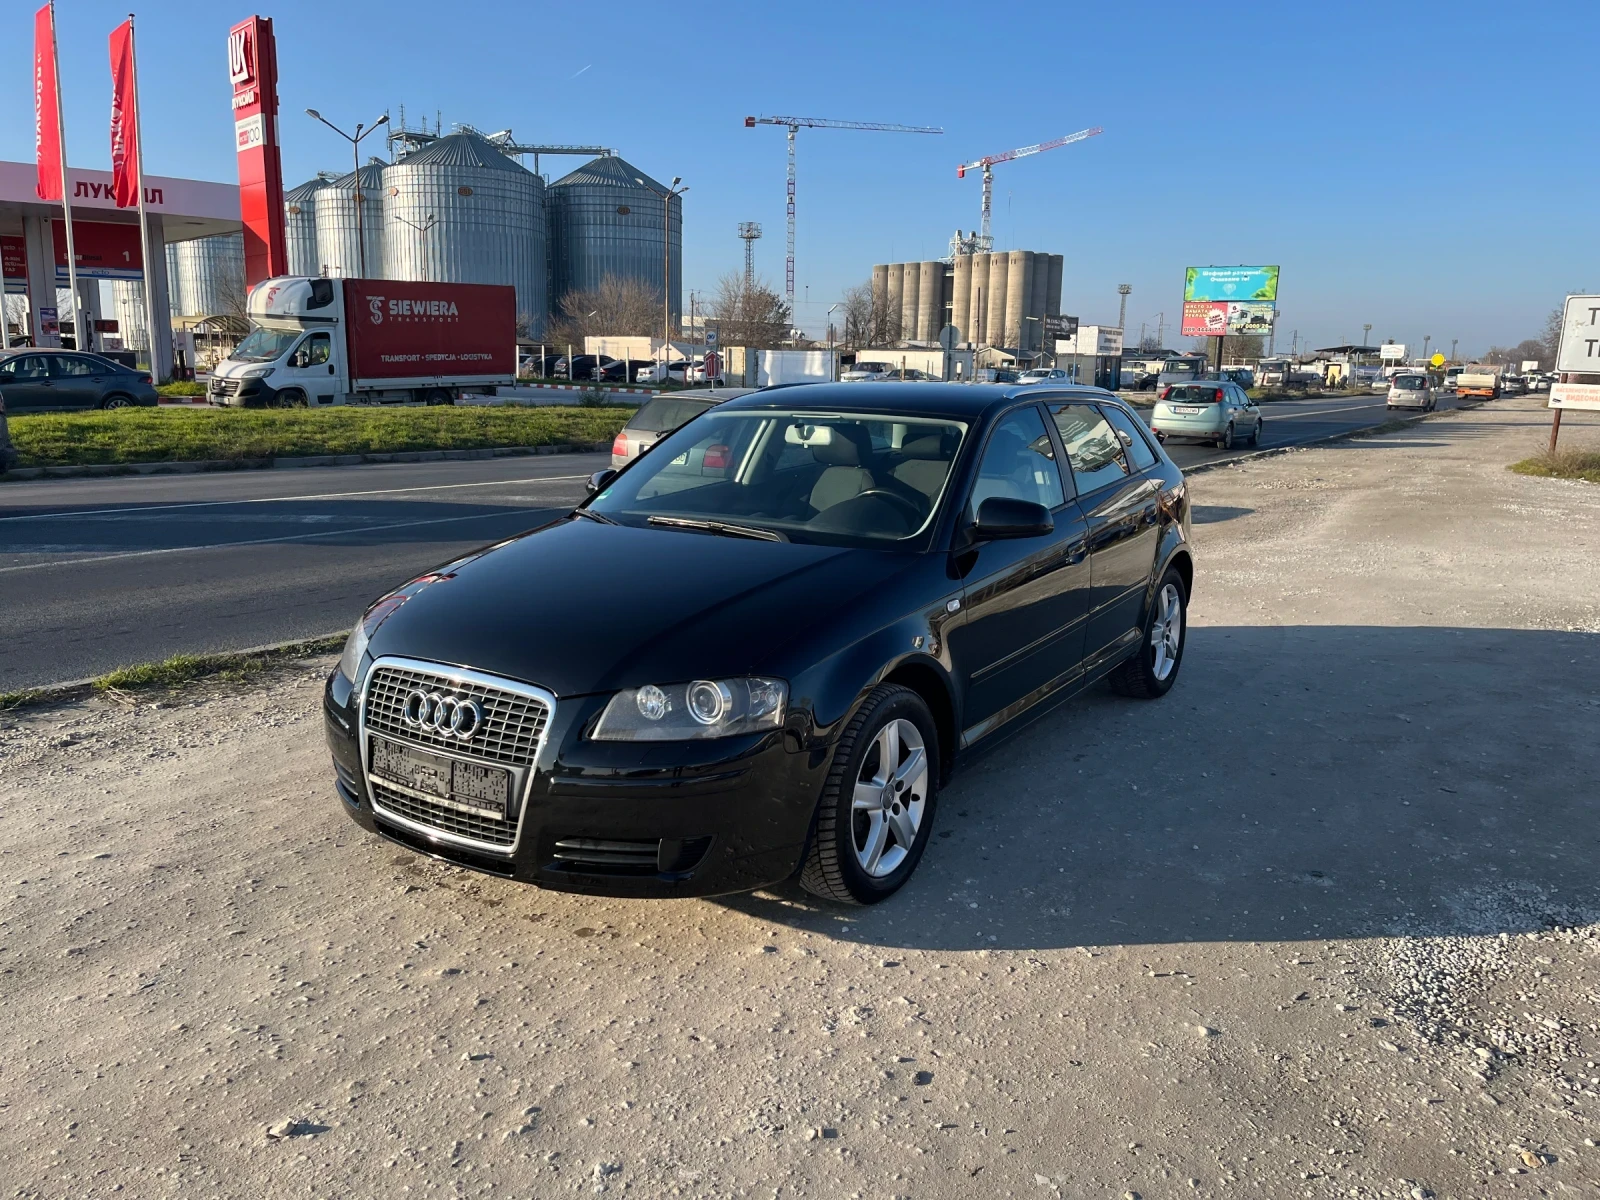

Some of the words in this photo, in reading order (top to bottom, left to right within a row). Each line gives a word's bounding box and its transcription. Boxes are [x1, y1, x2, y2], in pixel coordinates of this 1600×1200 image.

[122, 251, 130, 262] 1
[388, 299, 459, 316] SIEWIERA
[381, 354, 421, 363] TRANSPORT
[425, 353, 457, 362] SPEDYCJA
[460, 353, 493, 361] LOGISTYKA
